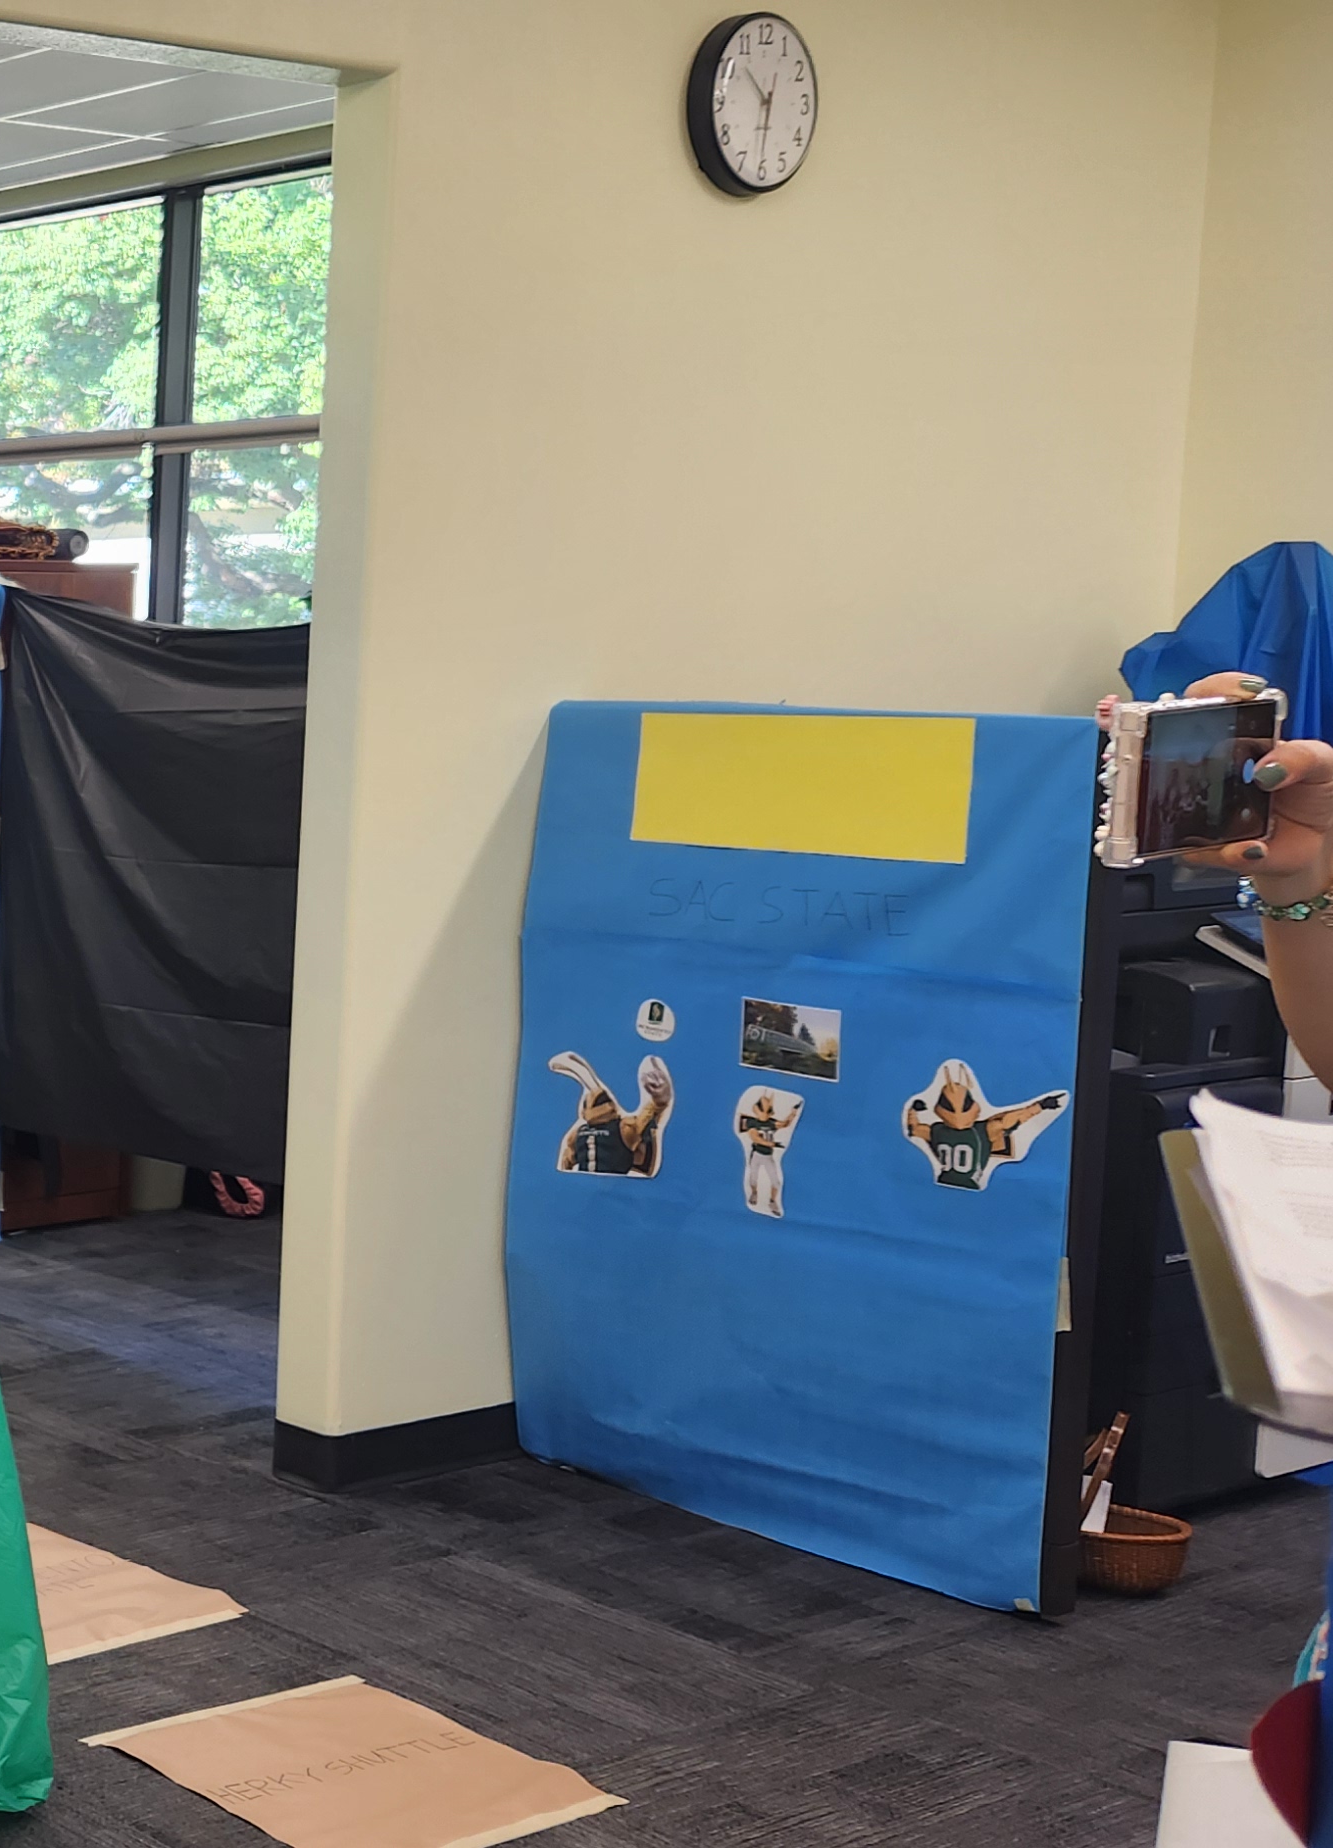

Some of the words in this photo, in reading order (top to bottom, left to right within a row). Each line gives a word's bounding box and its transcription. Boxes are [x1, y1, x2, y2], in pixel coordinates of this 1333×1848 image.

[738, 33, 751, 55] 11
[758, 23, 774, 45] 12
[781, 35, 789, 57] 1
[794, 60, 804, 82] 2
[800, 94, 810, 115] 3
[720, 124, 731, 146] 8
[792, 126, 803, 147] 4
[736, 151, 748, 172] 7
[757, 159, 767, 181] 6
[777, 151, 787, 173] 5
[649, 878, 734, 922] SAC
[758, 886, 910, 937] STATE
[937, 1143, 973, 1173] 00
[206, 1767, 323, 1805] HERKY
[324, 1731, 477, 1776] SHUTTLE
